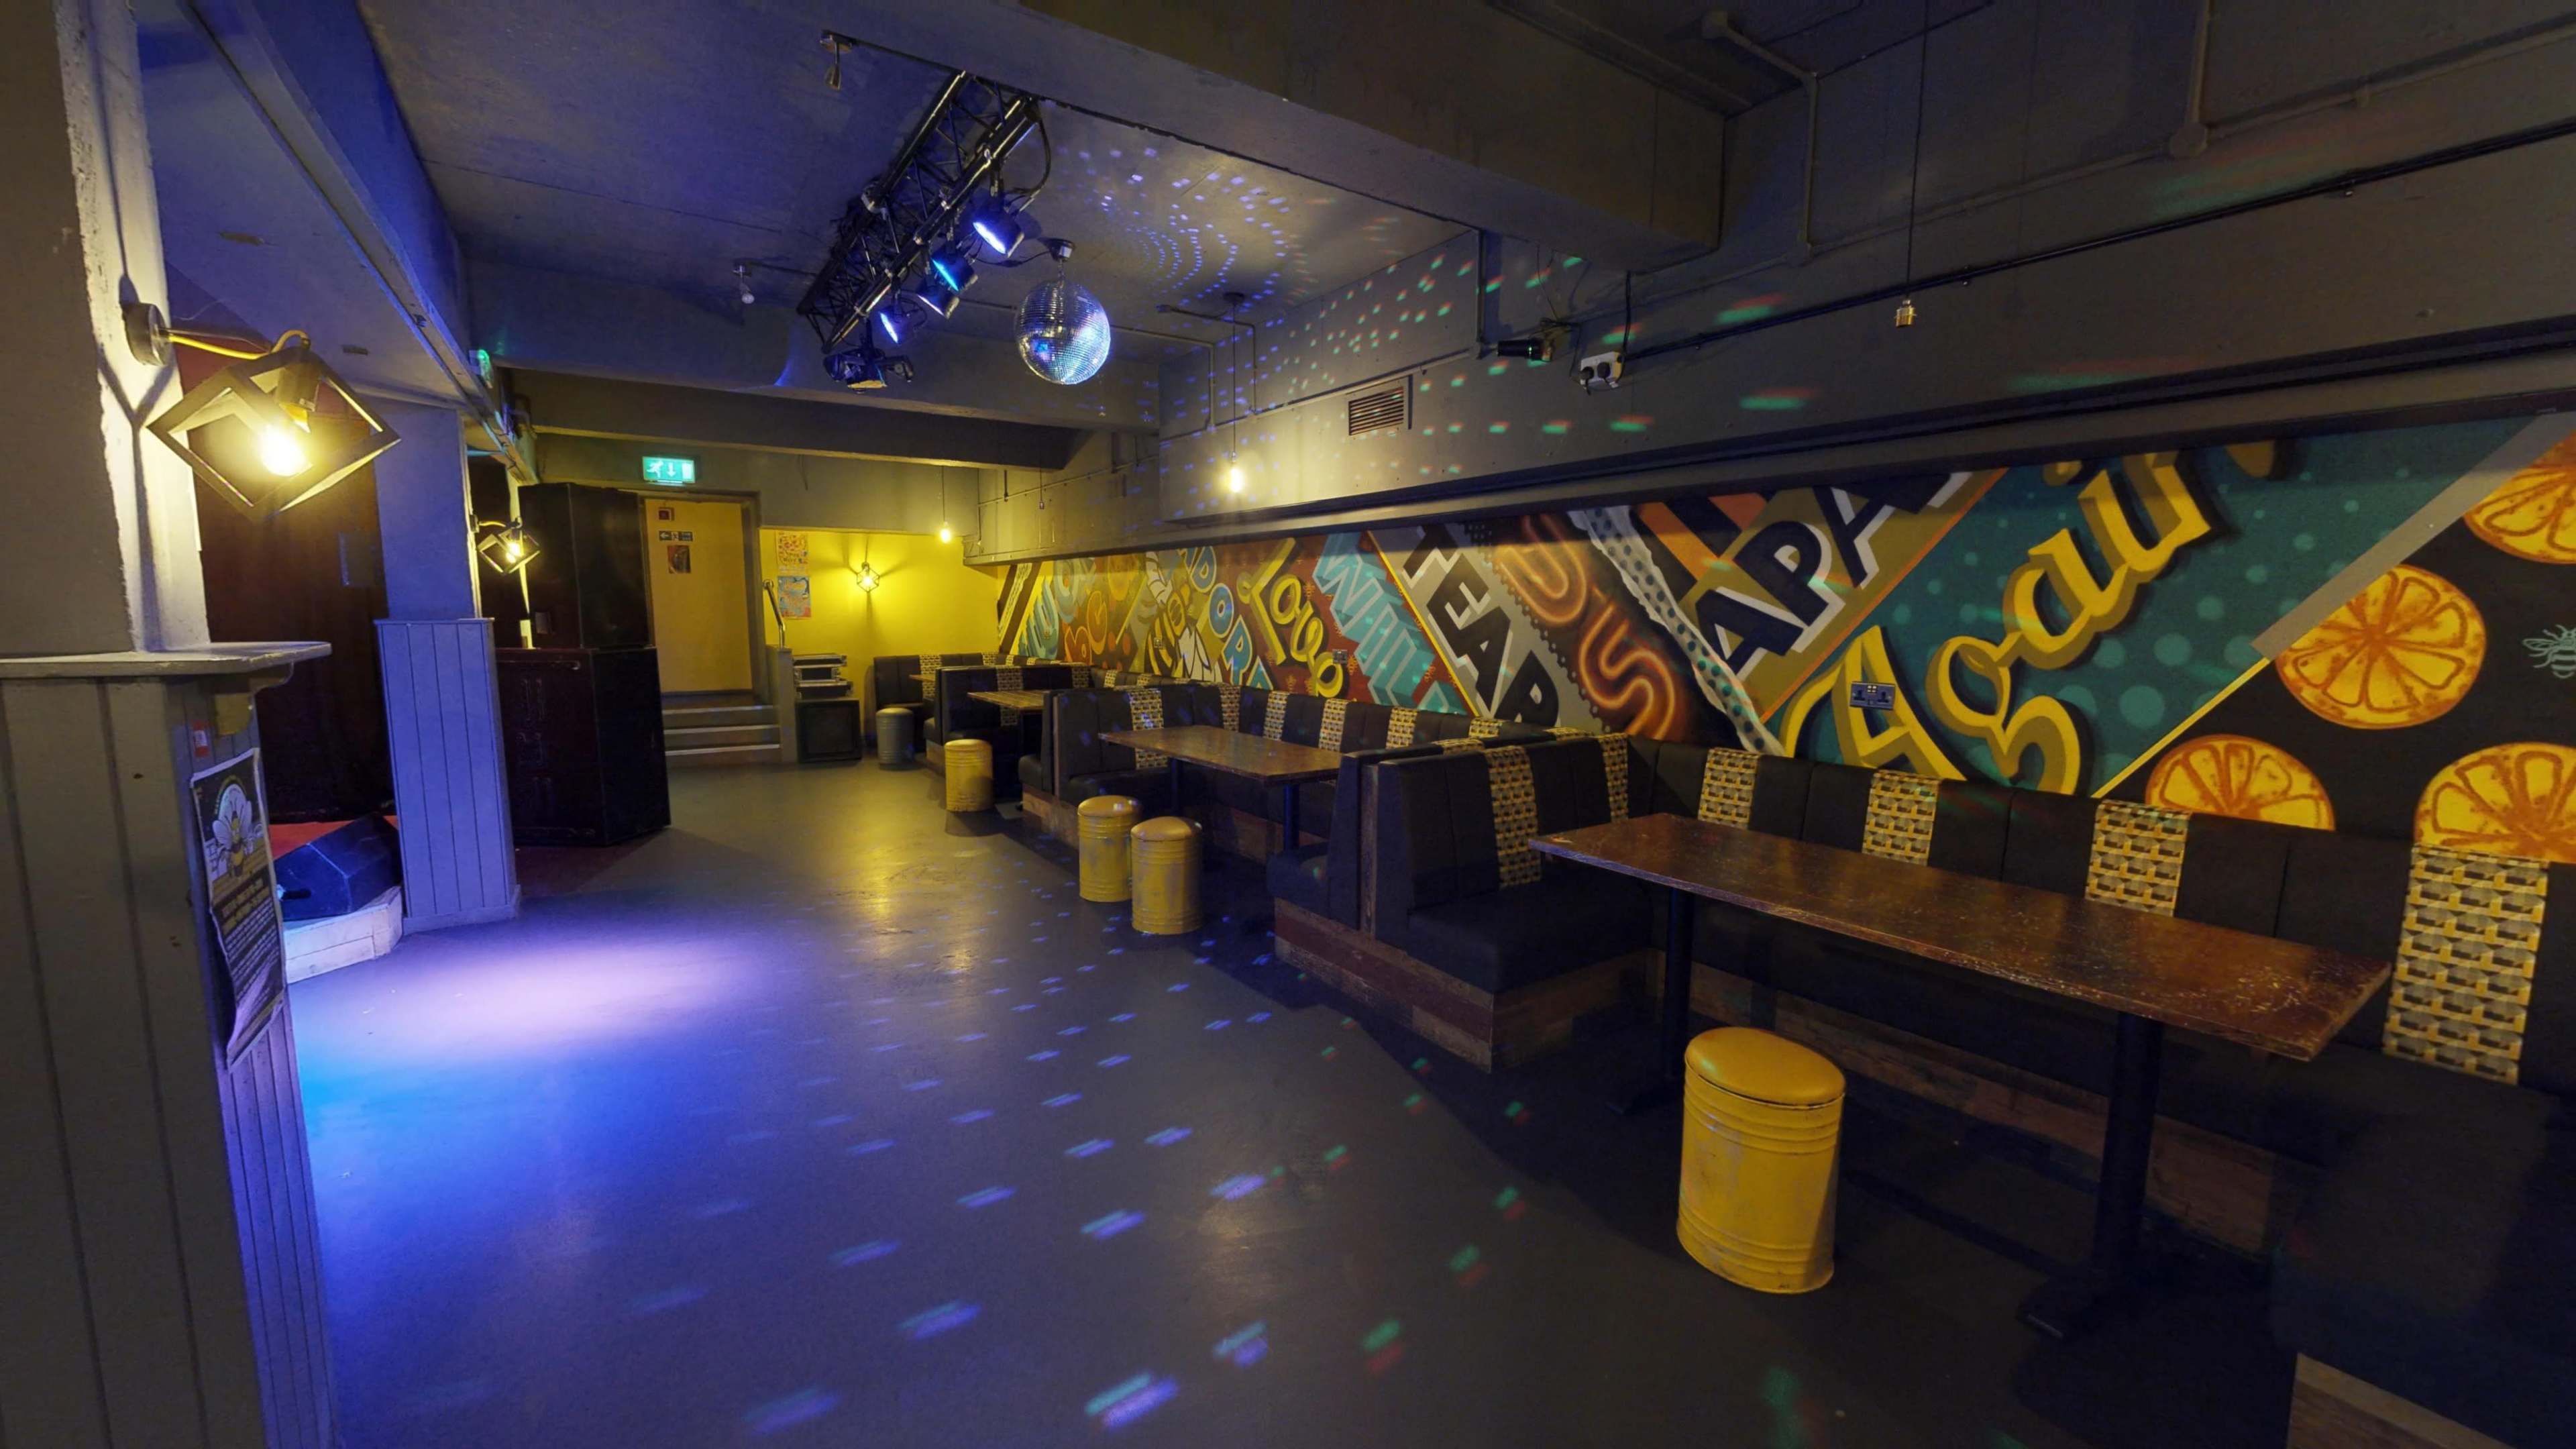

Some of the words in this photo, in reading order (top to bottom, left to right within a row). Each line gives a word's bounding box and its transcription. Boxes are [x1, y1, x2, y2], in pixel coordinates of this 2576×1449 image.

[1313, 533, 1462, 714] WIL
[1493, 513, 1675, 739] US
[1694, 471, 1955, 675] APA
